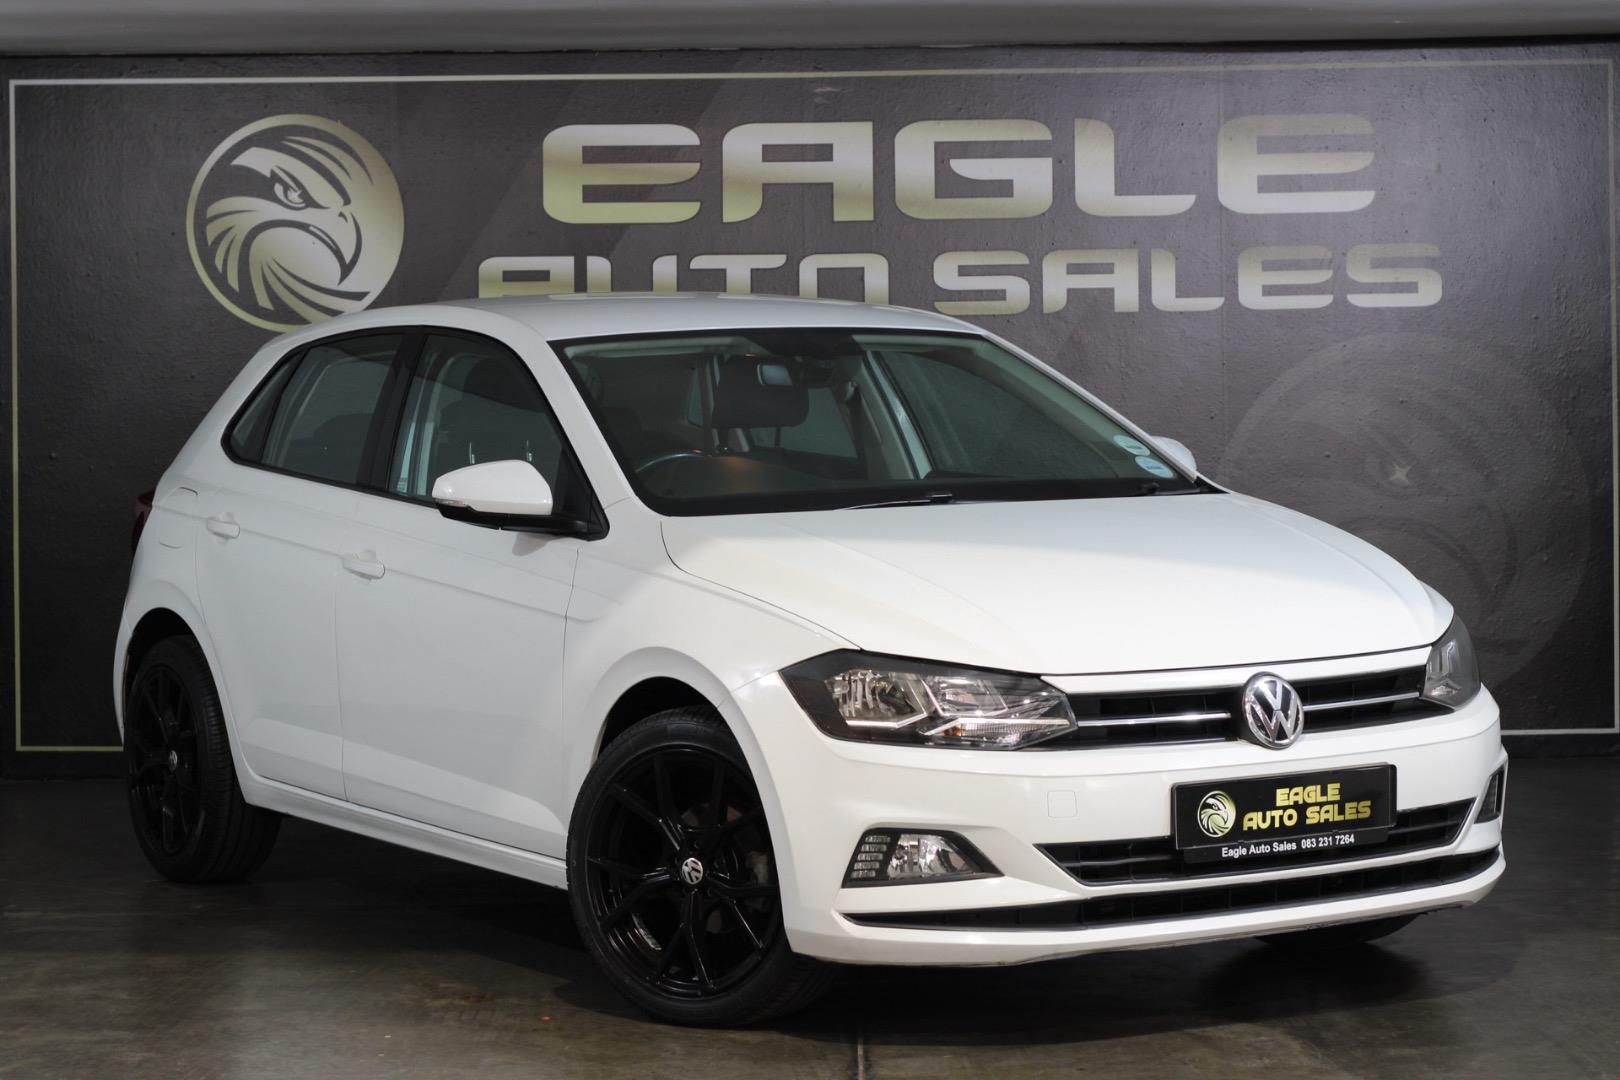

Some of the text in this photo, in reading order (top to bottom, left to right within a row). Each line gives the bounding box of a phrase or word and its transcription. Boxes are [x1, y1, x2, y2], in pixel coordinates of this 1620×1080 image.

[543, 113, 1376, 224] EAGLE
[933, 243, 1443, 316] SALES
[1245, 676, 1303, 747] VW
[1243, 800, 1371, 831] AUTO SALES
[1275, 783, 1341, 807] EAGLE
[1221, 834, 1355, 859] Eagle Auto Sales 083 231 7264
